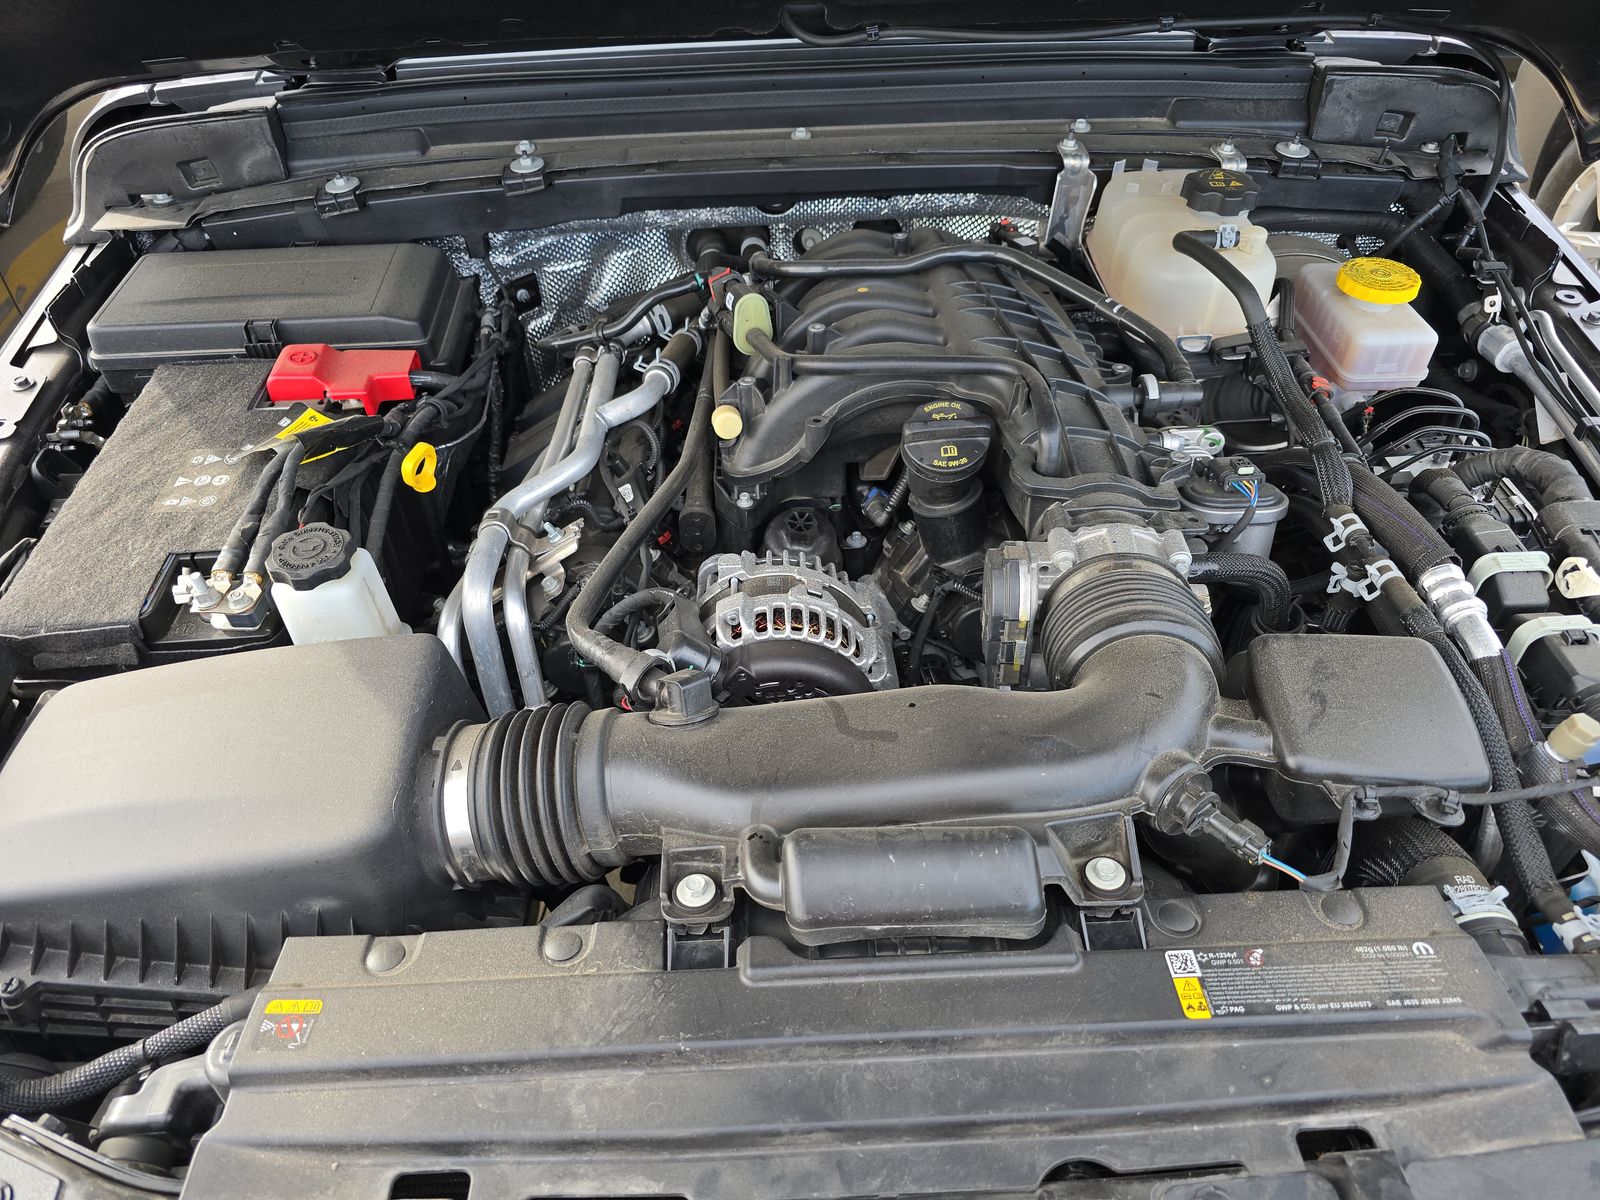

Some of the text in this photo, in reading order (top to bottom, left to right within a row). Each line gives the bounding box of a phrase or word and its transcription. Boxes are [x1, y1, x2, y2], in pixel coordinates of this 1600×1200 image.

[923, 402, 962, 413] ENGINE OIL
[932, 457, 968, 467] SAE 0W-20
[1454, 875, 1475, 884] RAD
[1208, 951, 1237, 959] R-1234yf
[1229, 1005, 1245, 1013] PAG
[1275, 1003, 1292, 1011] GWP
[1317, 1003, 1329, 1011] per
[1329, 1001, 1340, 1009] EU
